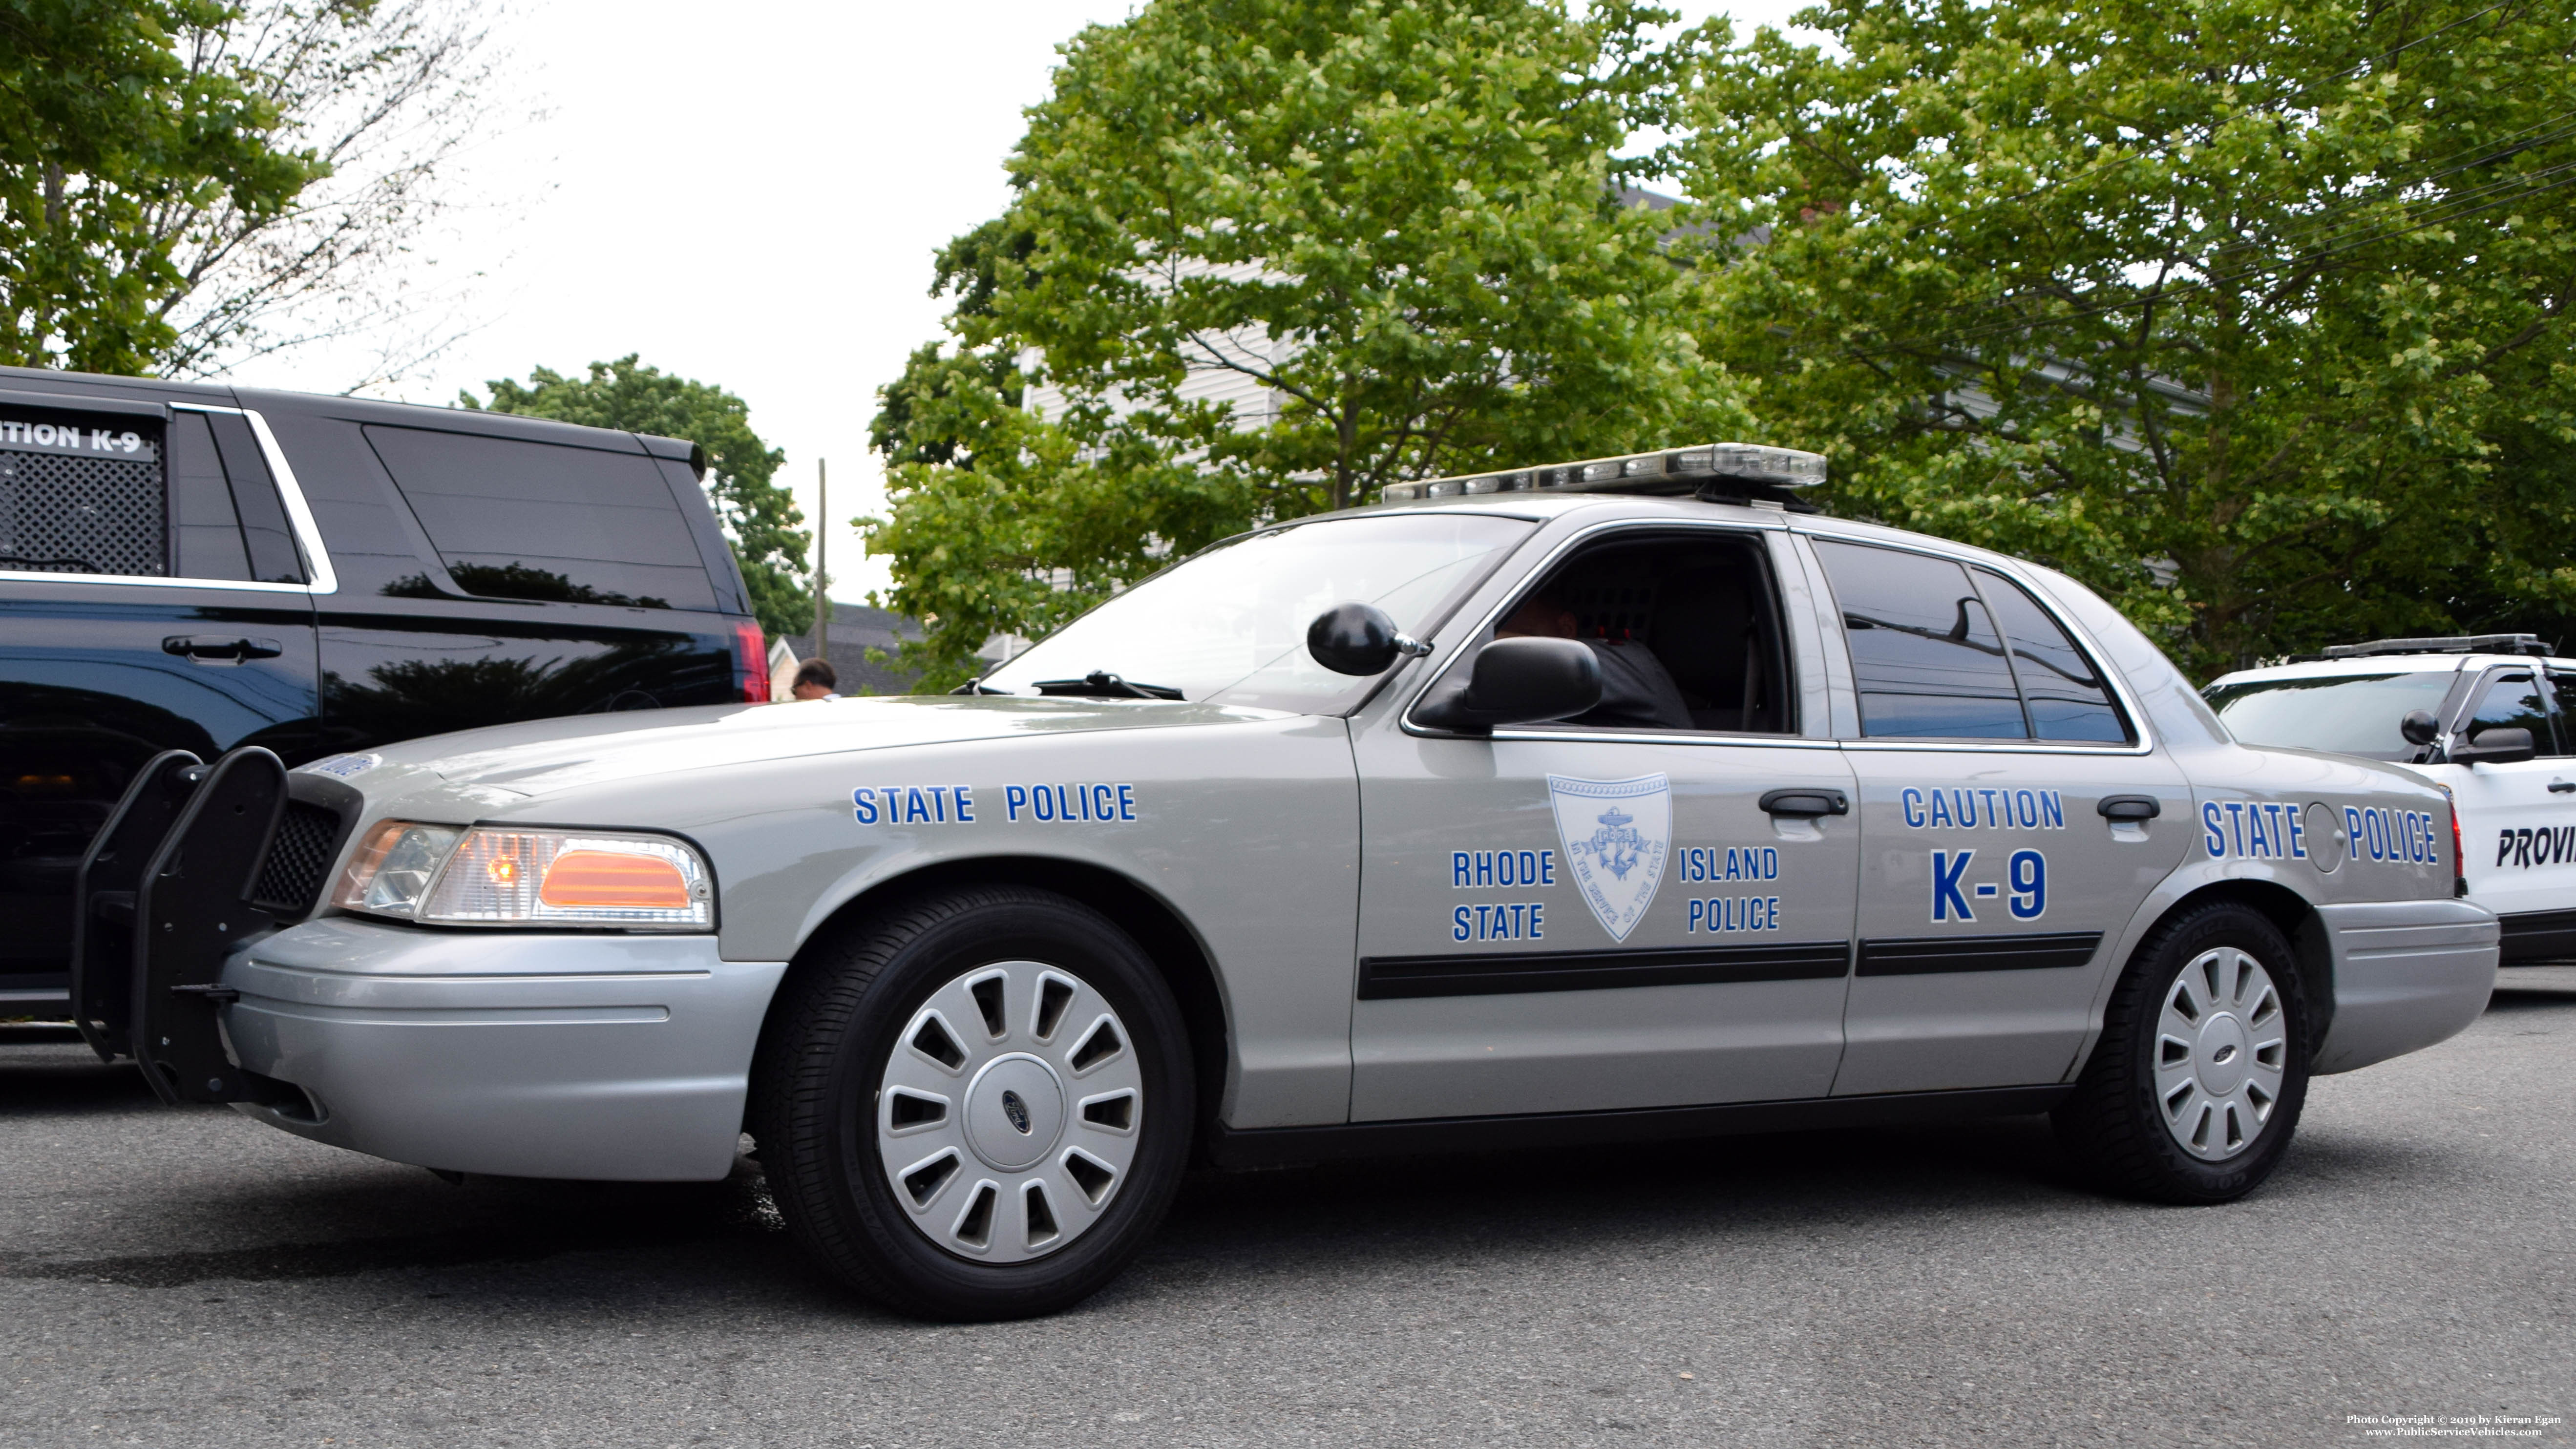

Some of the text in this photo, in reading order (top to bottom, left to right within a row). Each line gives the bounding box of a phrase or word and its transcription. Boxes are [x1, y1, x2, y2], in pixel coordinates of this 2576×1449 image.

[0, 420, 141, 453] TION K-9
[852, 782, 1137, 825] STATE POLICE
[1901, 786, 2066, 830] CAUTION
[1602, 831, 1630, 840] HOPE
[2201, 800, 2438, 866] STATE POLICE
[2496, 826, 2576, 870] PROVI
[1452, 846, 1779, 888] RHODE ISLAND
[1570, 840, 1582, 855] IN
[1623, 905, 1635, 923] OF
[1930, 848, 2048, 924] K-9
[1452, 896, 1779, 943] STATE POLICE
